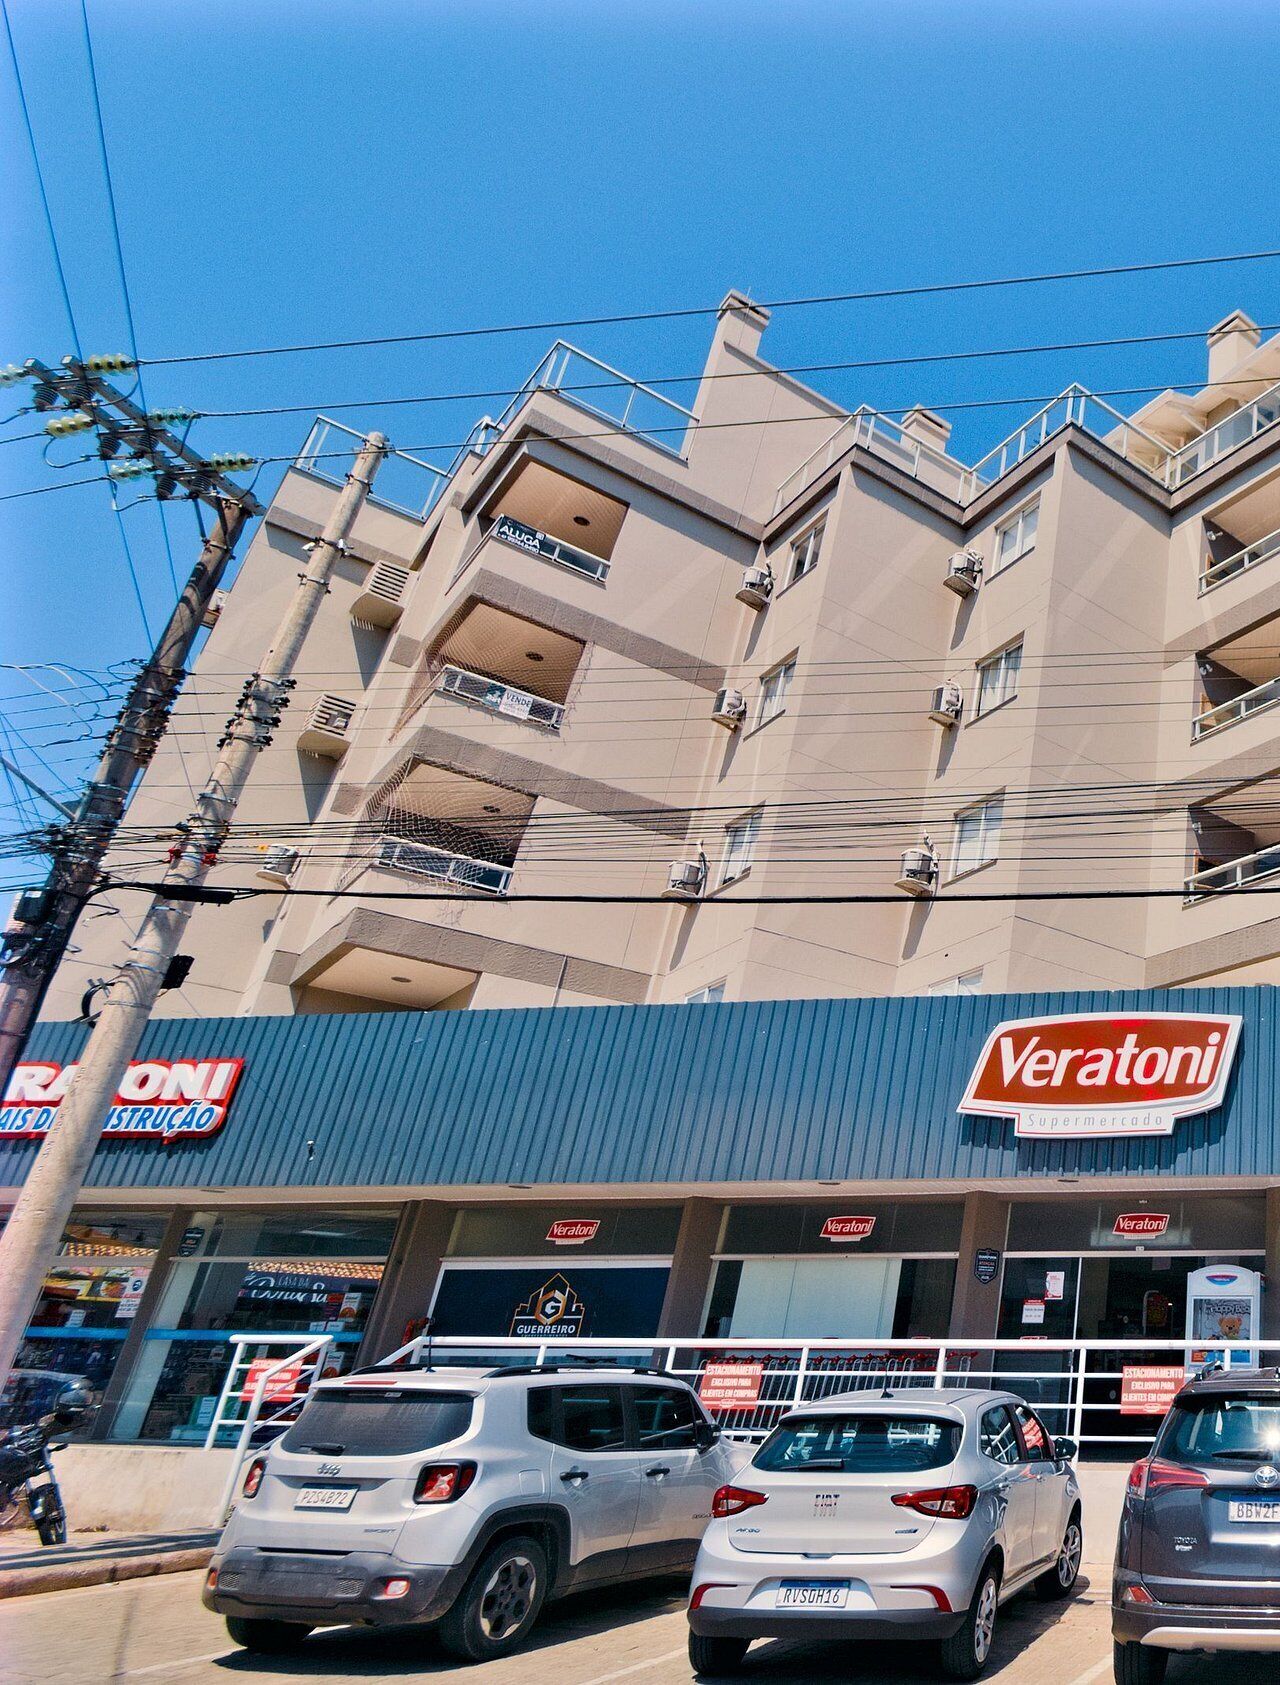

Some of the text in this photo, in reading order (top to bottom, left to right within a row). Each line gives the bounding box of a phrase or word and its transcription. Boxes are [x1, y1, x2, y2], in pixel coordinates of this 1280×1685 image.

[500, 525, 540, 549] ALUGA
[506, 692, 532, 708] VENDE
[1000, 1031, 1221, 1088] Veratoni
[4, 1063, 231, 1101] RAONI
[1028, 1113, 1163, 1130] Supermercado
[553, 1223, 597, 1236] Veratoni
[827, 1219, 873, 1233] Veratoni
[1119, 1217, 1168, 1231] Veratoni
[516, 1324, 576, 1334] GUERREIRO
[706, 1365, 763, 1376] ESTACIONAMENTO
[1124, 1367, 1184, 1379] ESTACIONAMENTO
[711, 1378, 752, 1387] EXCLUSIVO PARA
[1131, 1381, 1175, 1390] EXCLUSIVO PARA
[701, 1389, 758, 1398] CLIENTES EM COMPRAS
[1122, 1393, 1148, 1402] CLIENTES
[1148, 1393, 1157, 1402] EM
[1174, 1536, 1198, 1545] TOYOTA
